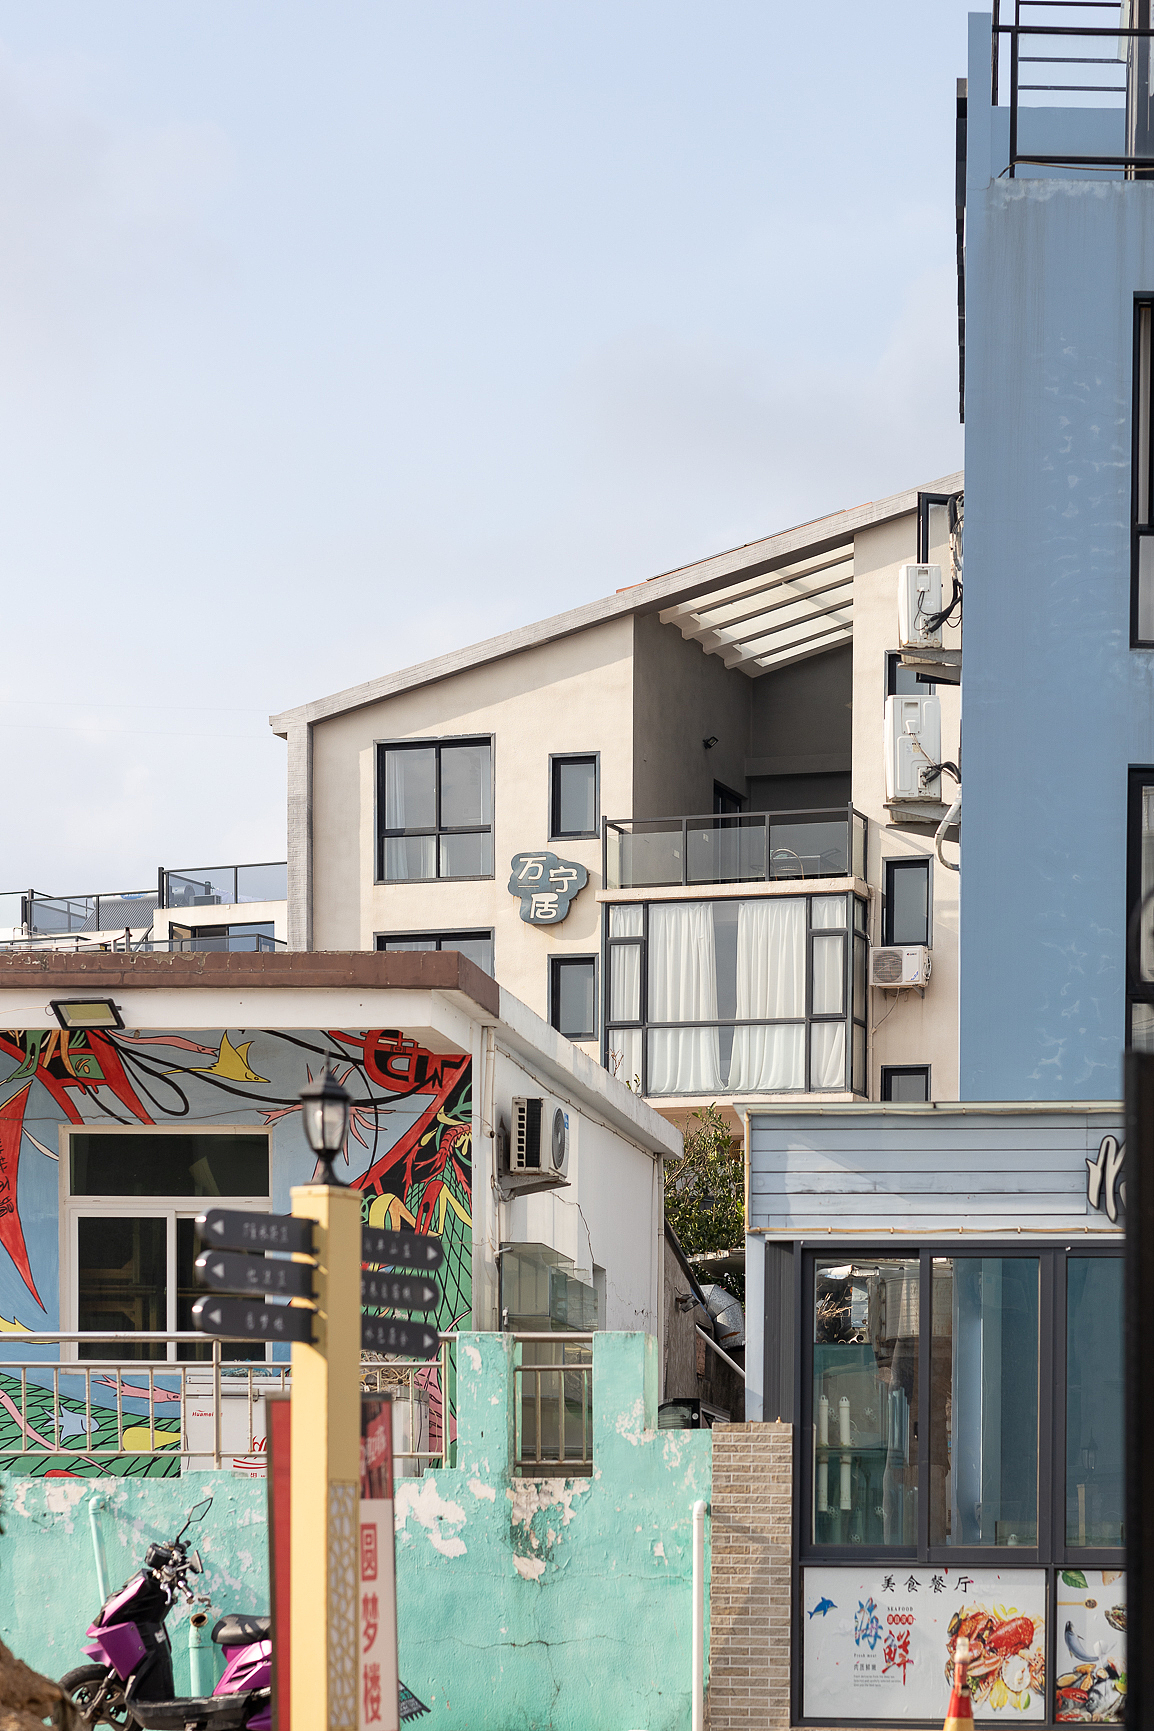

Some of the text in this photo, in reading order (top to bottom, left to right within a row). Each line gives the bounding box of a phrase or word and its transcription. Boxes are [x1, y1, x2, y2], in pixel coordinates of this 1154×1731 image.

[530, 892, 559, 919] 居
[881, 1574, 971, 1593] 美食餐厅
